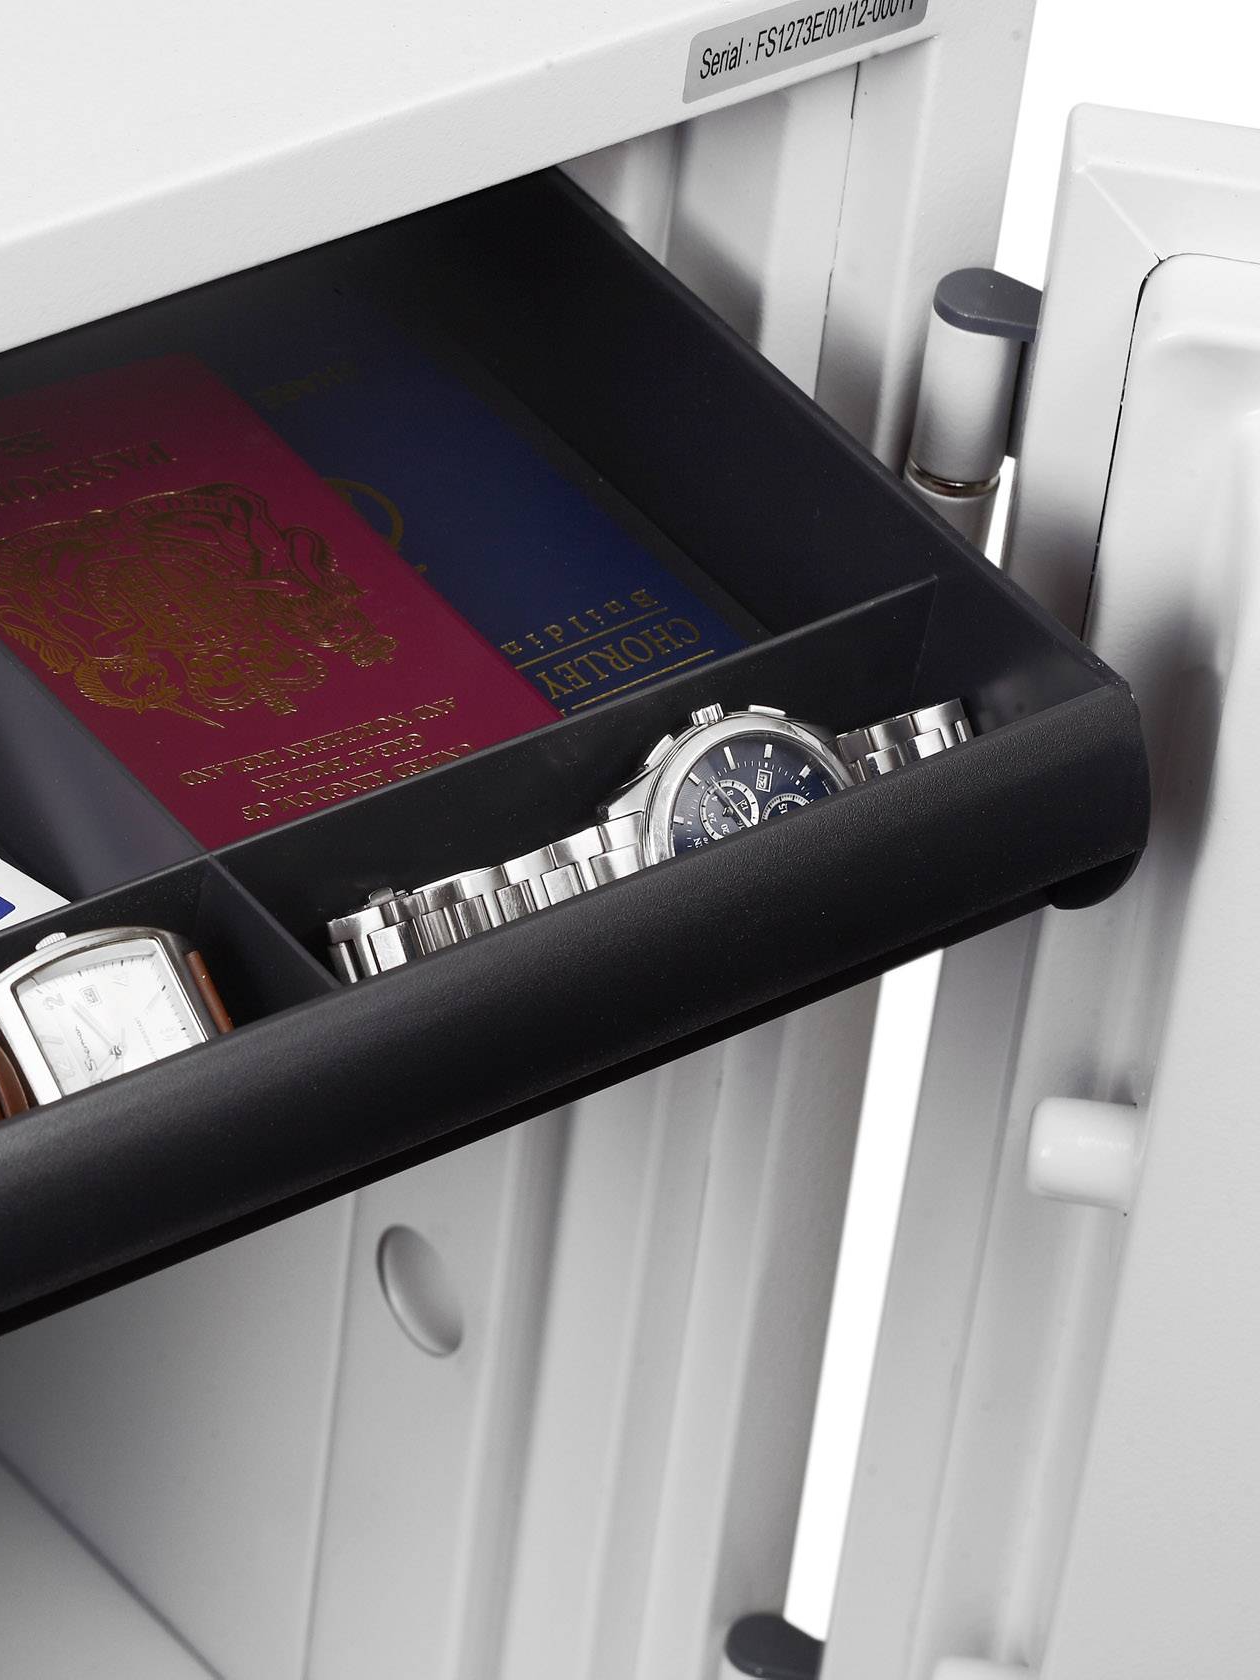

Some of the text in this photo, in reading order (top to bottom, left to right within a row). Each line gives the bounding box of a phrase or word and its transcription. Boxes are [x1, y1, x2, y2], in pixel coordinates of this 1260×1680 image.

[700, 38, 743, 79] Serial
[536, 617, 701, 700] CHORLEY
[178, 696, 456, 786] AND NORTHERN IRELAND
[251, 733, 424, 793] GREAT BRITAIN
[273, 769, 391, 812] KINGDOM
